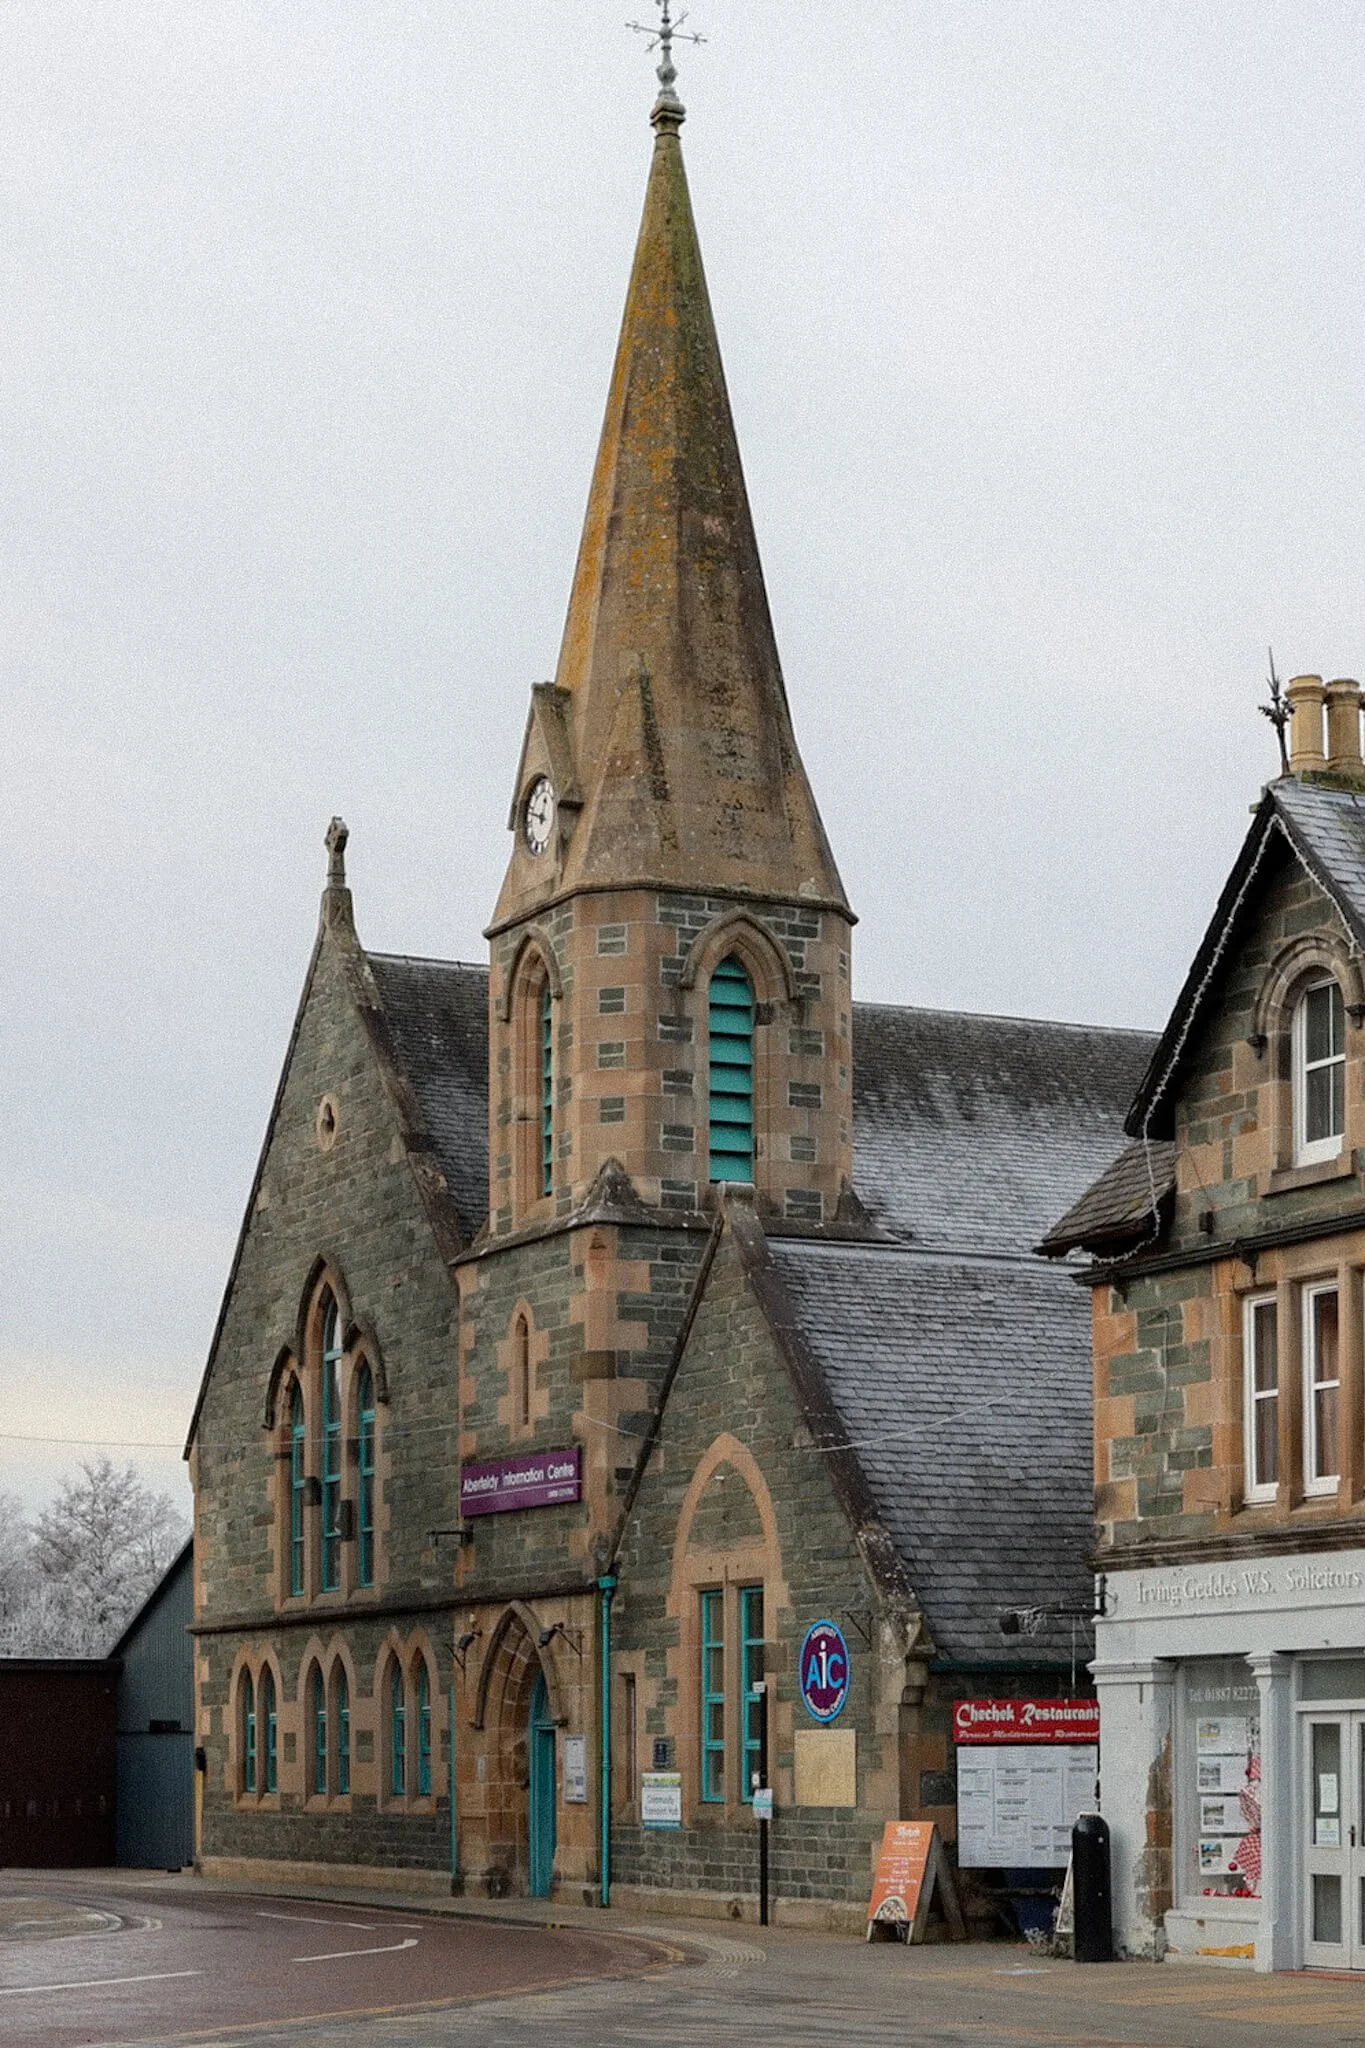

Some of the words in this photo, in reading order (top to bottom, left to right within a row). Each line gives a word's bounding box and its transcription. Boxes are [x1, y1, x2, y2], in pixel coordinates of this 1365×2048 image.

[463, 1474, 499, 1493] Aberfeldy
[547, 1463, 575, 1480] Centre
[1183, 1574, 1239, 1600] Geddes
[1286, 1565, 1363, 1592] Solicitors
[1020, 1703, 1099, 1727] Restaurant
